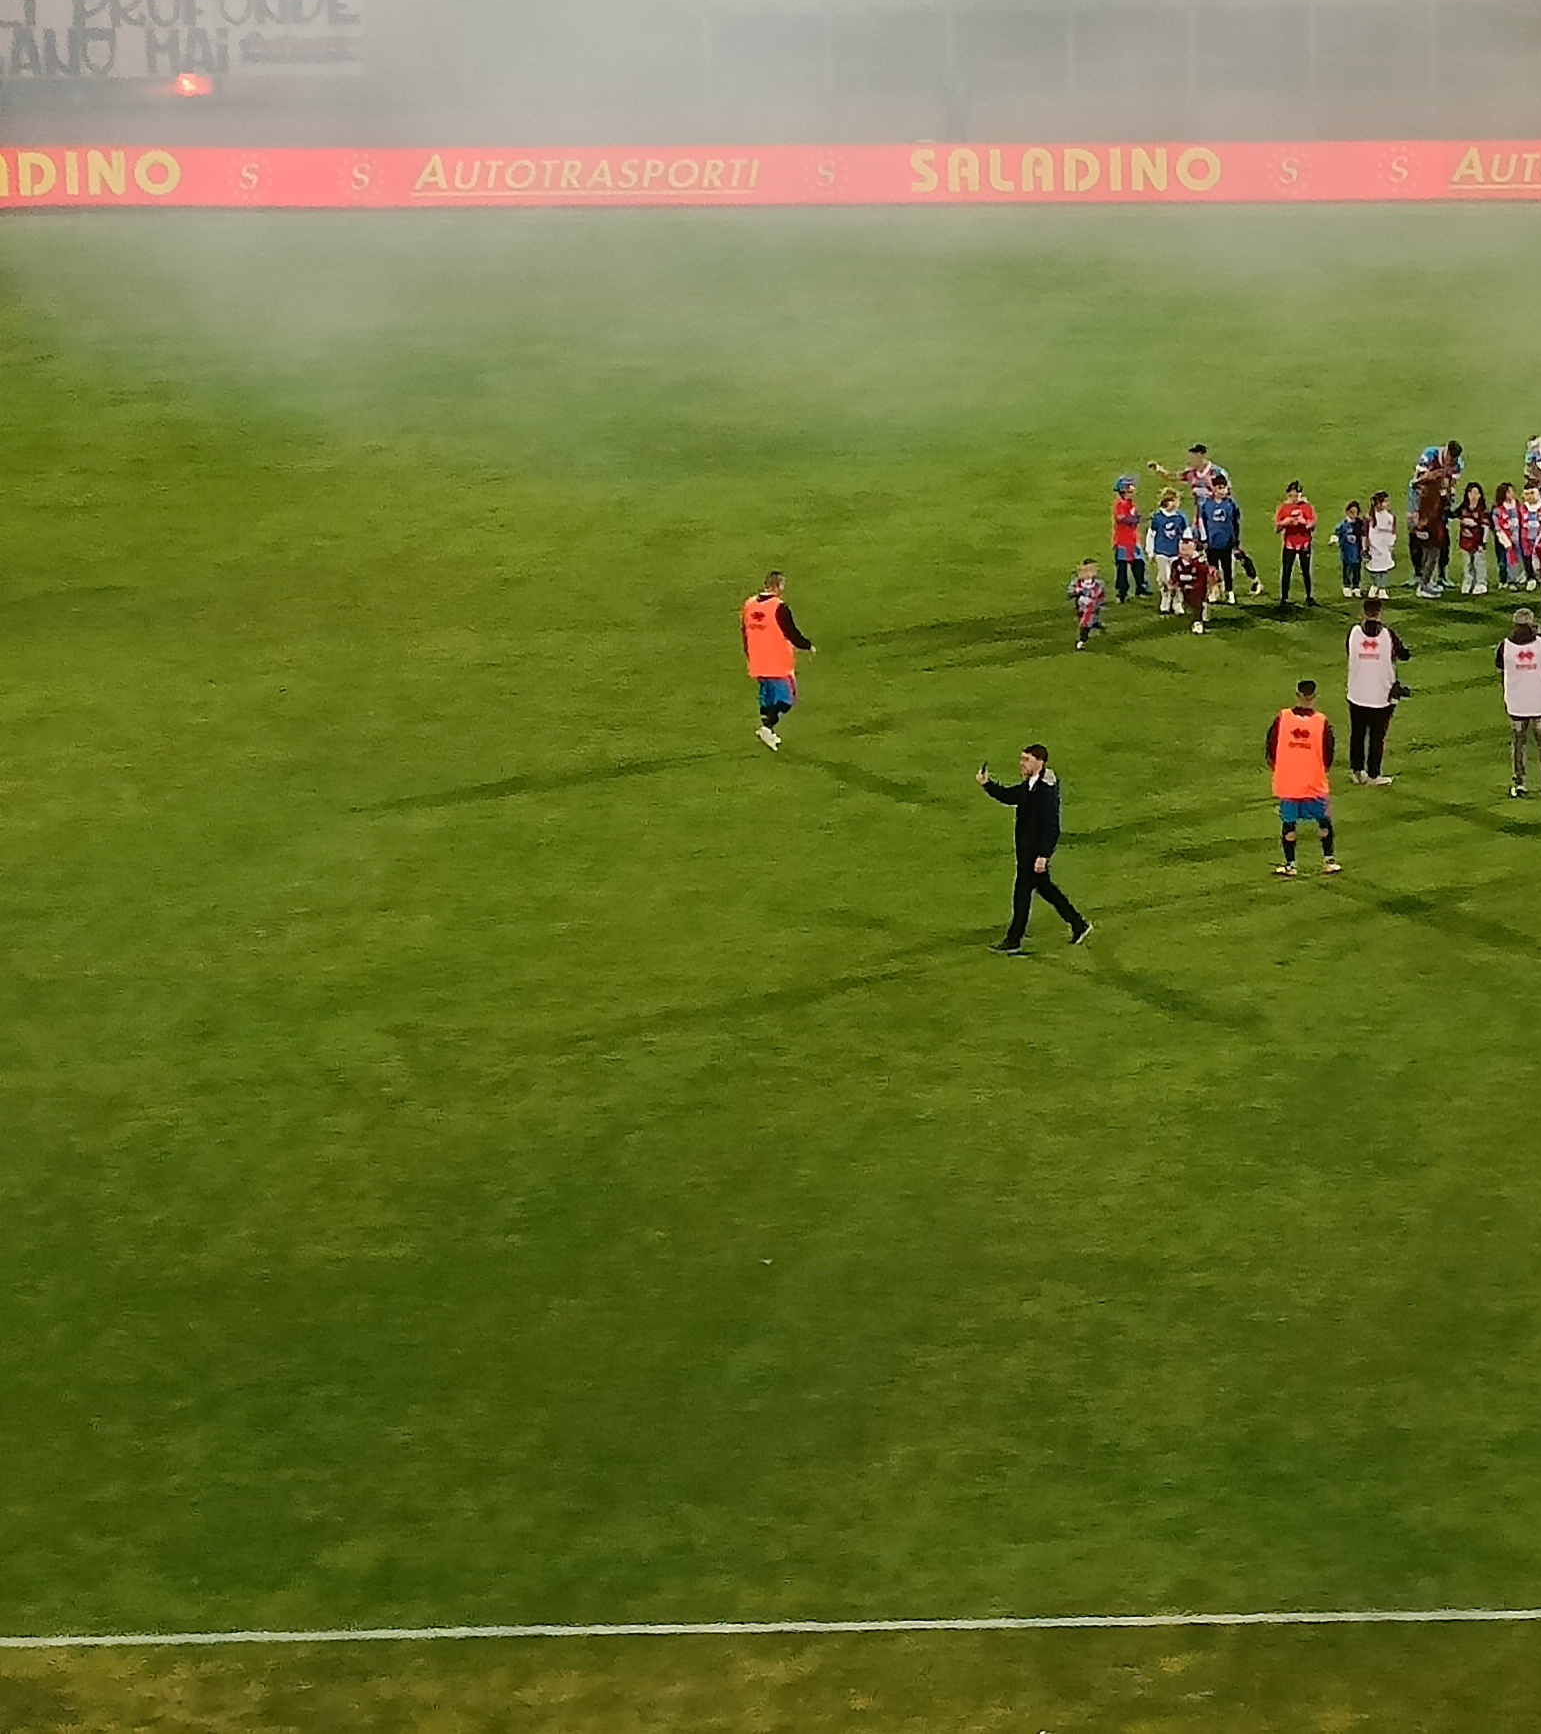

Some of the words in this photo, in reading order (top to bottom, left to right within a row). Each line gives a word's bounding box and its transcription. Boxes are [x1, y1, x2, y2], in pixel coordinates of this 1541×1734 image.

[0, 149, 181, 197] DINO
[414, 153, 760, 189] AUTOTRASPORTI
[911, 146, 1222, 193] SALADINO
